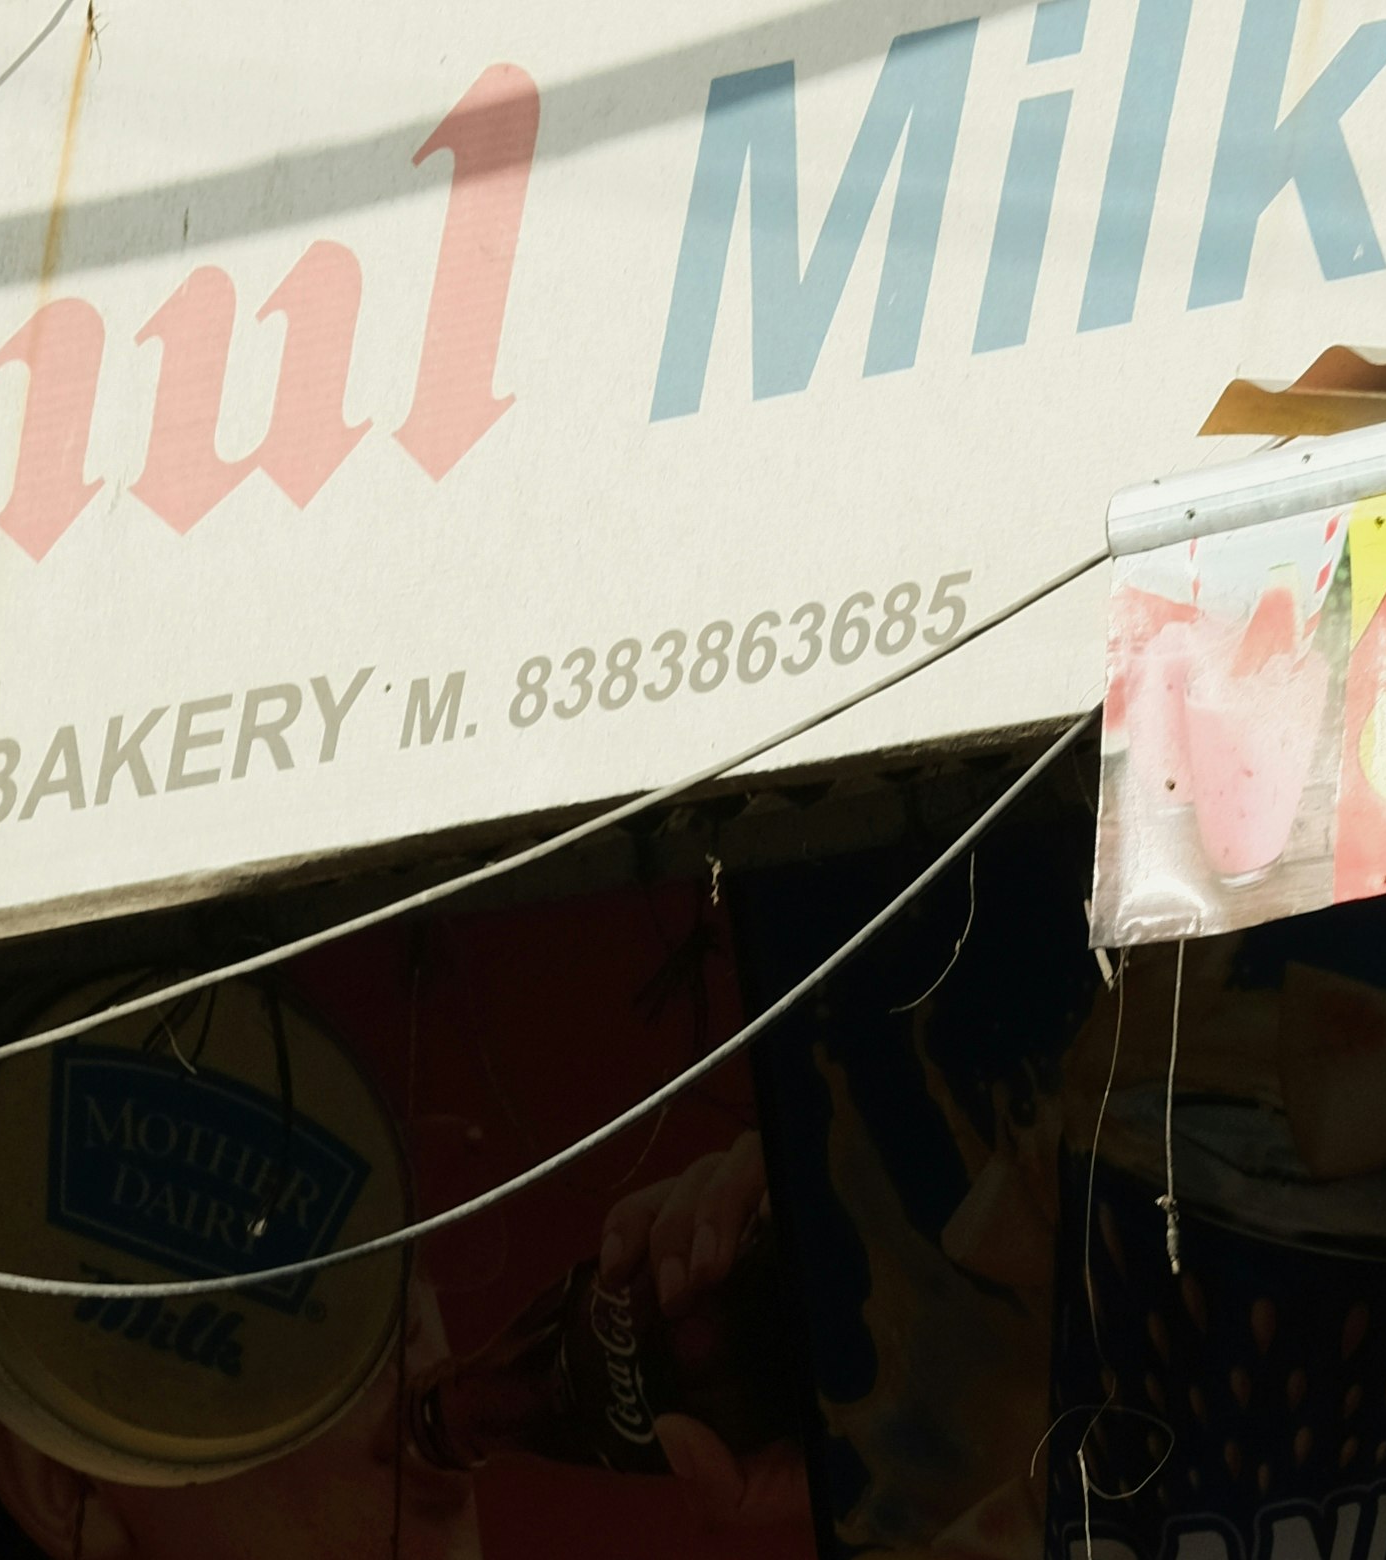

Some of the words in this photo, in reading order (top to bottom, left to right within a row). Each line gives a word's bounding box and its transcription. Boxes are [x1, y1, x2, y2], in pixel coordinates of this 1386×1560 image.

[398, 675, 479, 751] M.
[507, 571, 974, 732] 8383863685
[83, 1093, 324, 1233] MOTHER
[112, 1162, 264, 1260] DAIRY
[73, 1262, 243, 1377] Milk
[591, 1273, 655, 1446] Coca-Col
